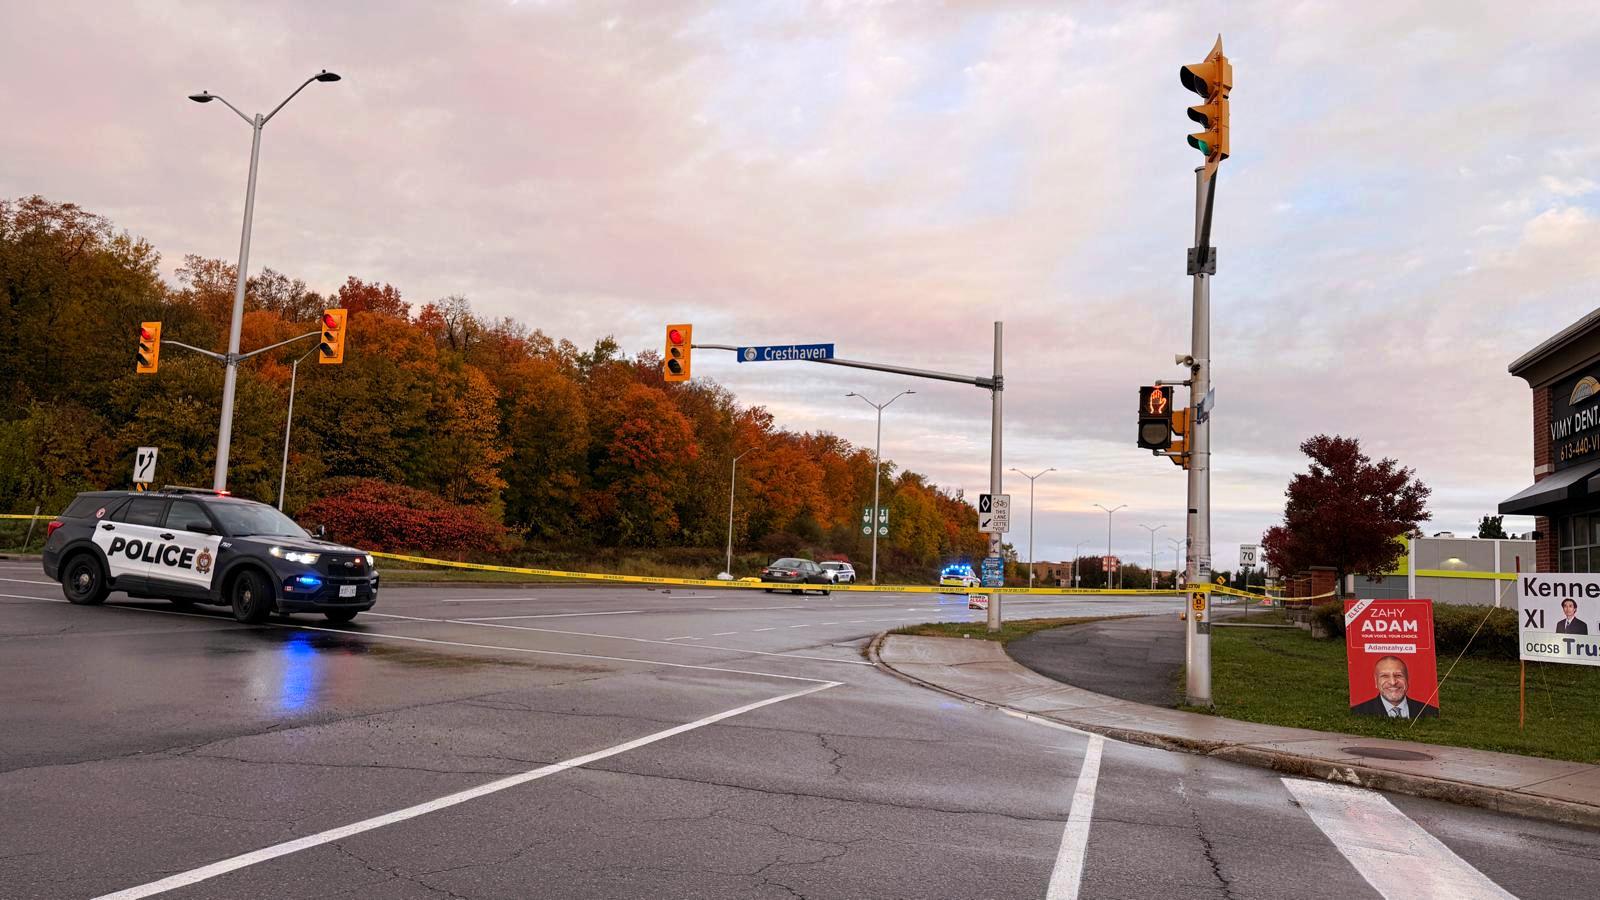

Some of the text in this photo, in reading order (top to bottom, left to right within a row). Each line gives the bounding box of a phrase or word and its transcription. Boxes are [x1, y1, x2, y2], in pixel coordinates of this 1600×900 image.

[764, 346, 826, 360] Cresthaven
[1551, 405, 1600, 440] VIMY DENT
[107, 537, 197, 569] POLICE
[1243, 552, 1254, 561] 70
[1524, 577, 1600, 598] Kenne
[1348, 602, 1366, 619] ELECT
[1370, 608, 1405, 618] ZAHY
[1524, 609, 1545, 628] XI
[1361, 620, 1418, 632] ADAM
[1368, 644, 1413, 652] Adamzahy.ca
[1526, 642, 1560, 654] OCDSB
